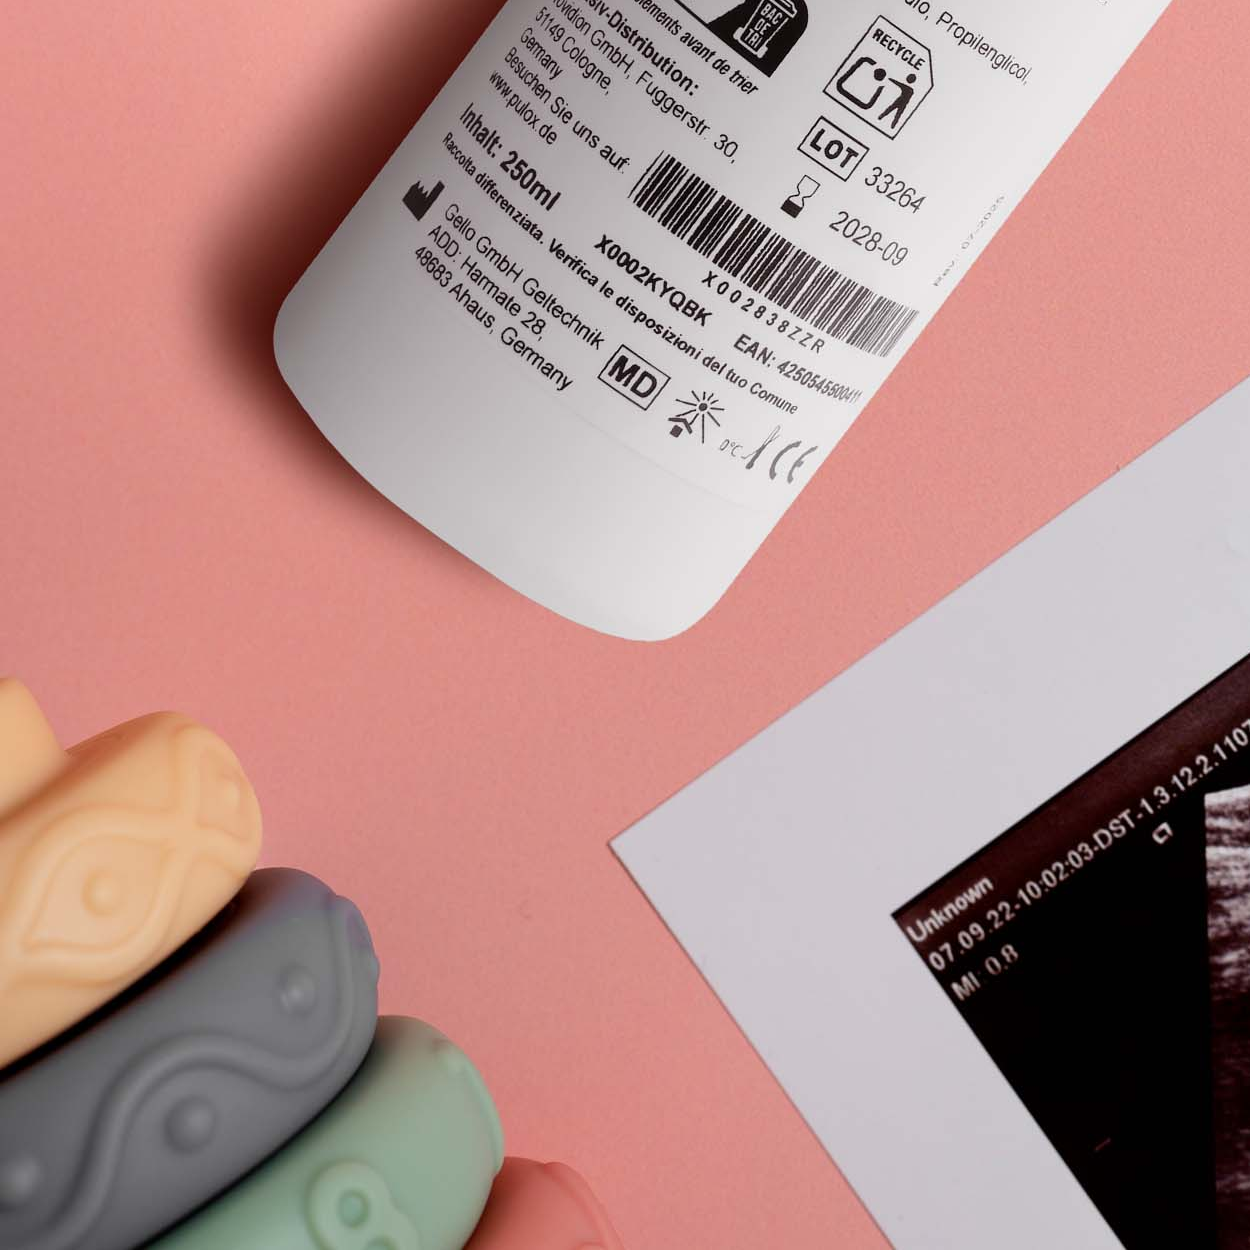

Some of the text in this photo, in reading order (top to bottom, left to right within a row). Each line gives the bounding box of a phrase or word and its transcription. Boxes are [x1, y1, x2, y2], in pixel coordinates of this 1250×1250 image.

[740, 27, 764, 50] TRI
[752, 17, 772, 37] DE
[758, 1, 785, 27] BAC
[871, 28, 926, 71] RECYCLE
[520, 27, 564, 81] Germany
[535, 6, 612, 96] 51149 Cologne,
[679, 32, 717, 63] avant
[711, 58, 731, 75] de
[728, 69, 759, 95] trier
[489, 72, 569, 145] www.pulox.de
[504, 46, 631, 175] Besuchen Sie uns auf:
[590, 29, 635, 80] GmbH,
[635, 70, 711, 136] Fuggerstr.
[713, 133, 739, 164] 30,
[459, 102, 562, 212] Inhalt: 250ml
[809, 128, 927, 214] LOT 33264
[442, 131, 798, 415] Raccolta differenziata. Verifica le disposizioni del tuo Comune
[828, 210, 909, 266] 2028-09
[427, 224, 547, 342] ADD: Harmate 28,
[444, 203, 605, 351] Gello GmbH Geltechnik
[593, 234, 713, 327] X0002KYQBK
[415, 246, 574, 392] 48683 Ahaus, Germany
[733, 333, 776, 368] EAN:
[607, 354, 658, 399] MD
[905, 877, 994, 942] Unknown
